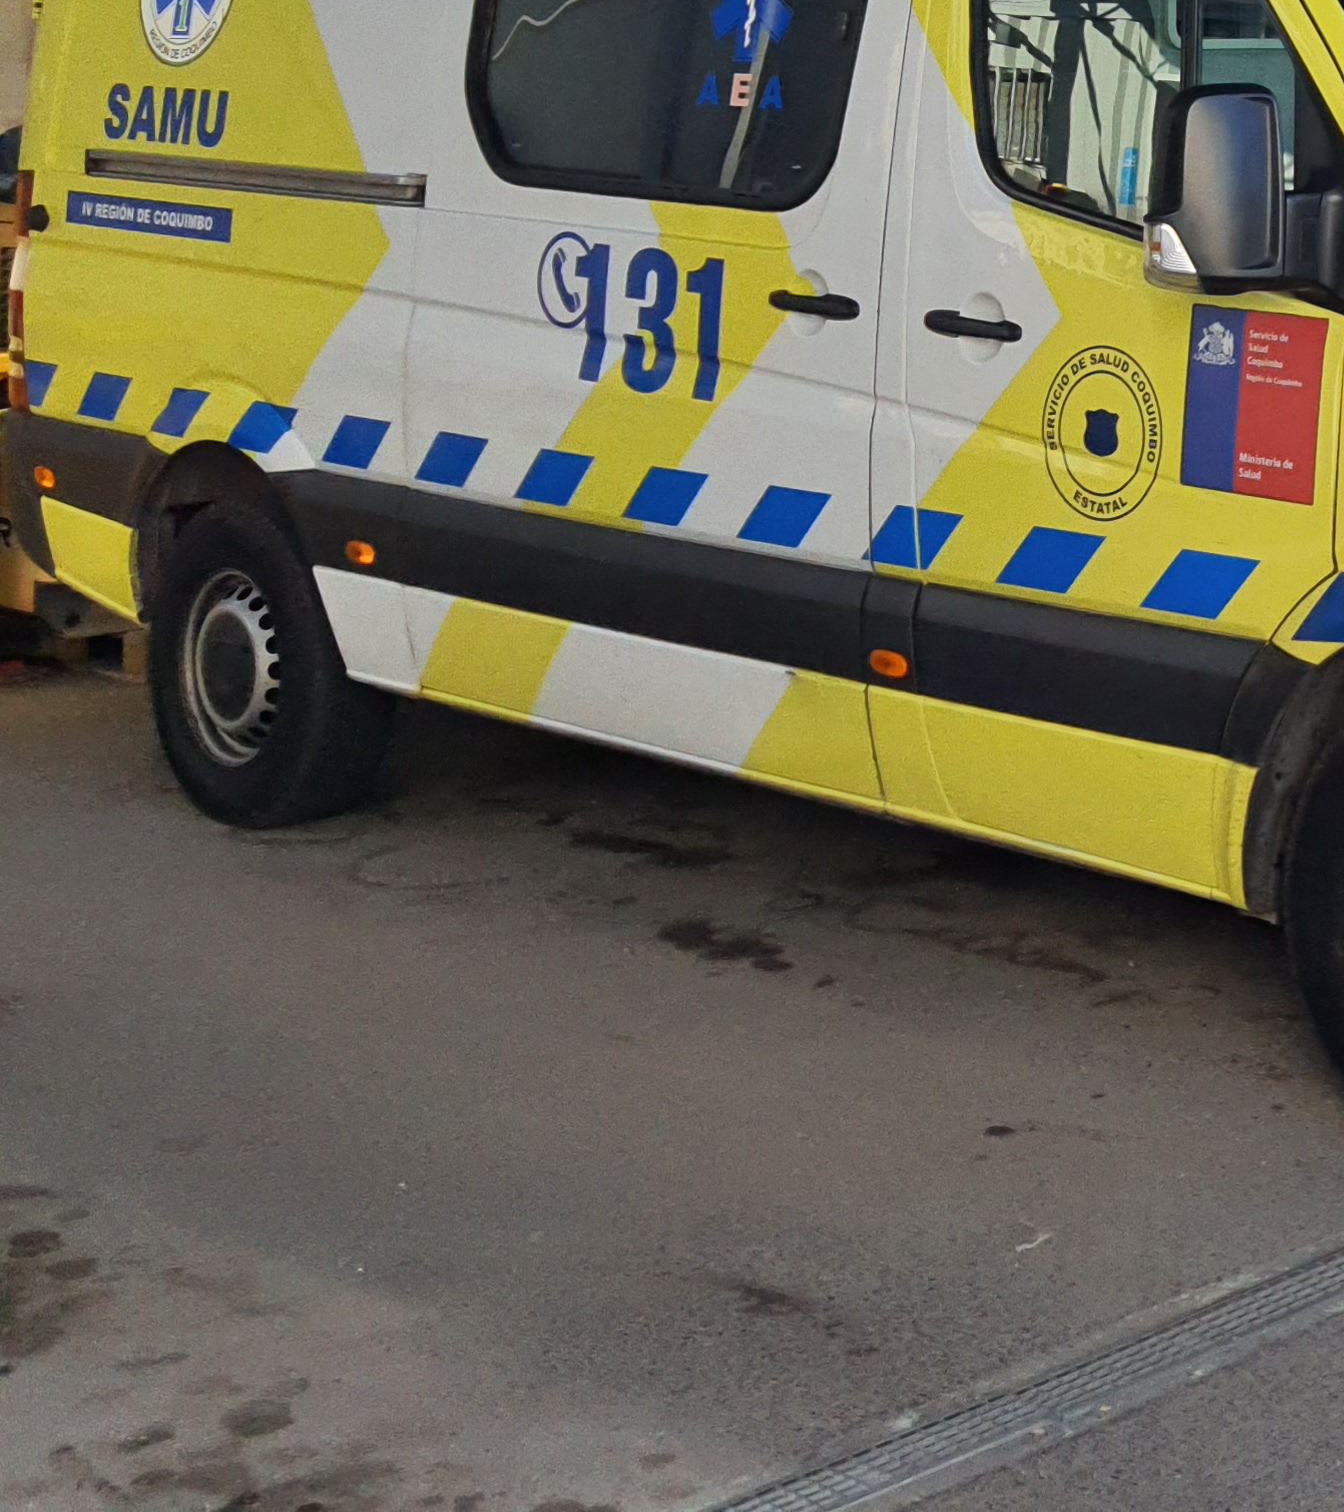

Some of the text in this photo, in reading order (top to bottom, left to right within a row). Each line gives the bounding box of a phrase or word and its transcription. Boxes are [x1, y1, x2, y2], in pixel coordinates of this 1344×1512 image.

[104, 83, 229, 148] SAMU
[82, 201, 213, 231] IV REGIÓN DE COQUIMBO
[574, 242, 725, 402] 131
[1249, 330, 1289, 343] Servicio de
[1249, 343, 1268, 354] Salud
[1247, 356, 1283, 370] Coquimbo
[1046, 352, 1158, 463] SERVICIO DE SALUD COQUIMBO
[1239, 451, 1294, 469] Ministerio de
[1238, 468, 1261, 480] Salud
[1073, 490, 1127, 514] ESTATAL
